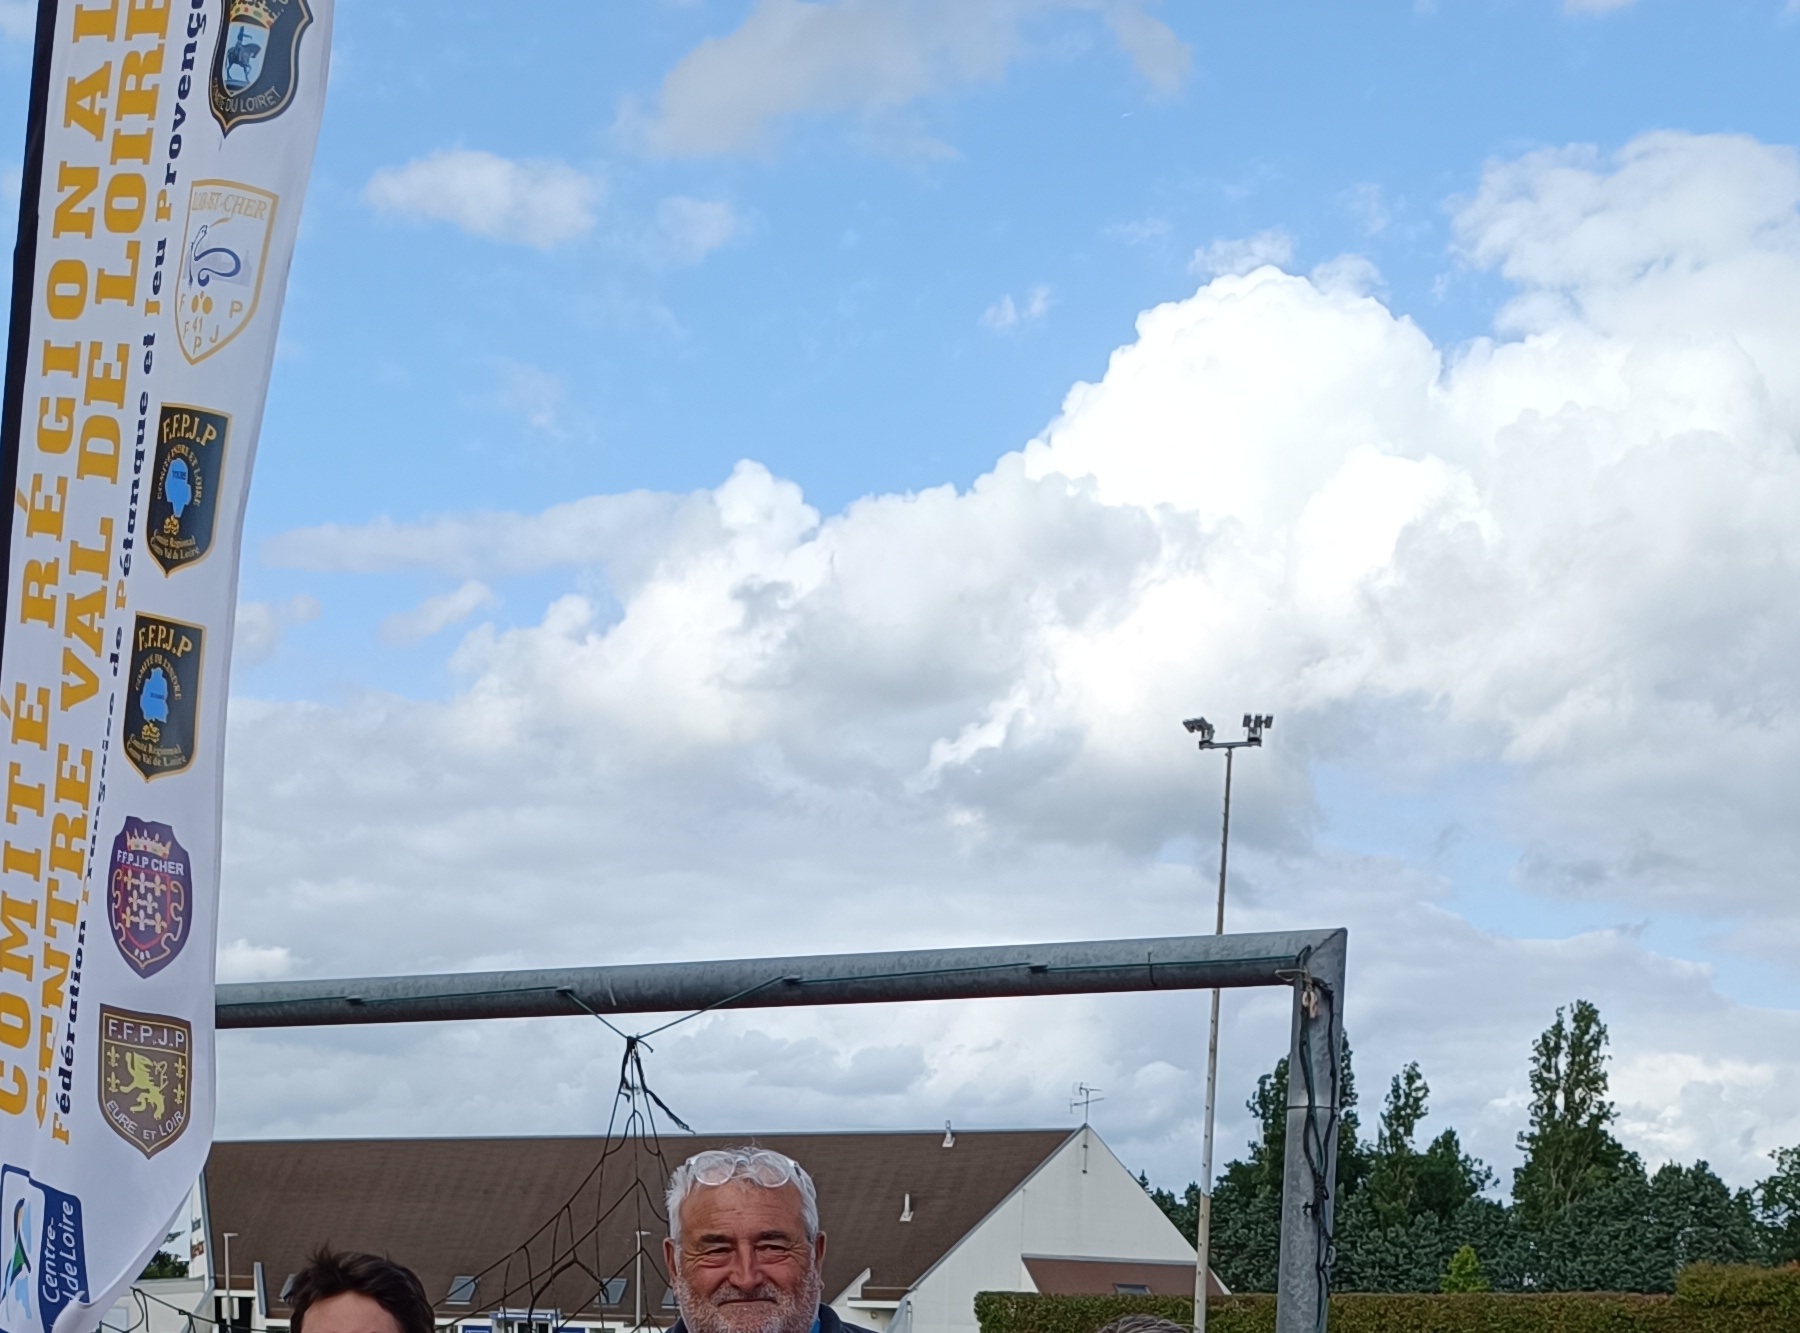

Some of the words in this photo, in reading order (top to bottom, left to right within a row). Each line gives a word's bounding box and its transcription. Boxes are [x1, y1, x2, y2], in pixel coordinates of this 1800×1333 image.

[94, 0, 172, 307] LOIRE
[229, 298, 244, 319] P
[76, 340, 130, 485] DE
[53, 919, 87, 1146] Fédération
[115, 391, 149, 611] Pétanque
[143, 332, 156, 375] et
[155, 0, 207, 222] Provenç
[60, 517, 114, 712] VAL
[0, 681, 51, 1116] COMITÉ
[151, 859, 184, 876] CHER
[106, 1100, 138, 1135] EURE
[143, 1129, 157, 1141] ET
[158, 1111, 184, 1136] LOIR
[42, 1216, 60, 1303] Centre-
[58, 1201, 77, 1262] Loire
